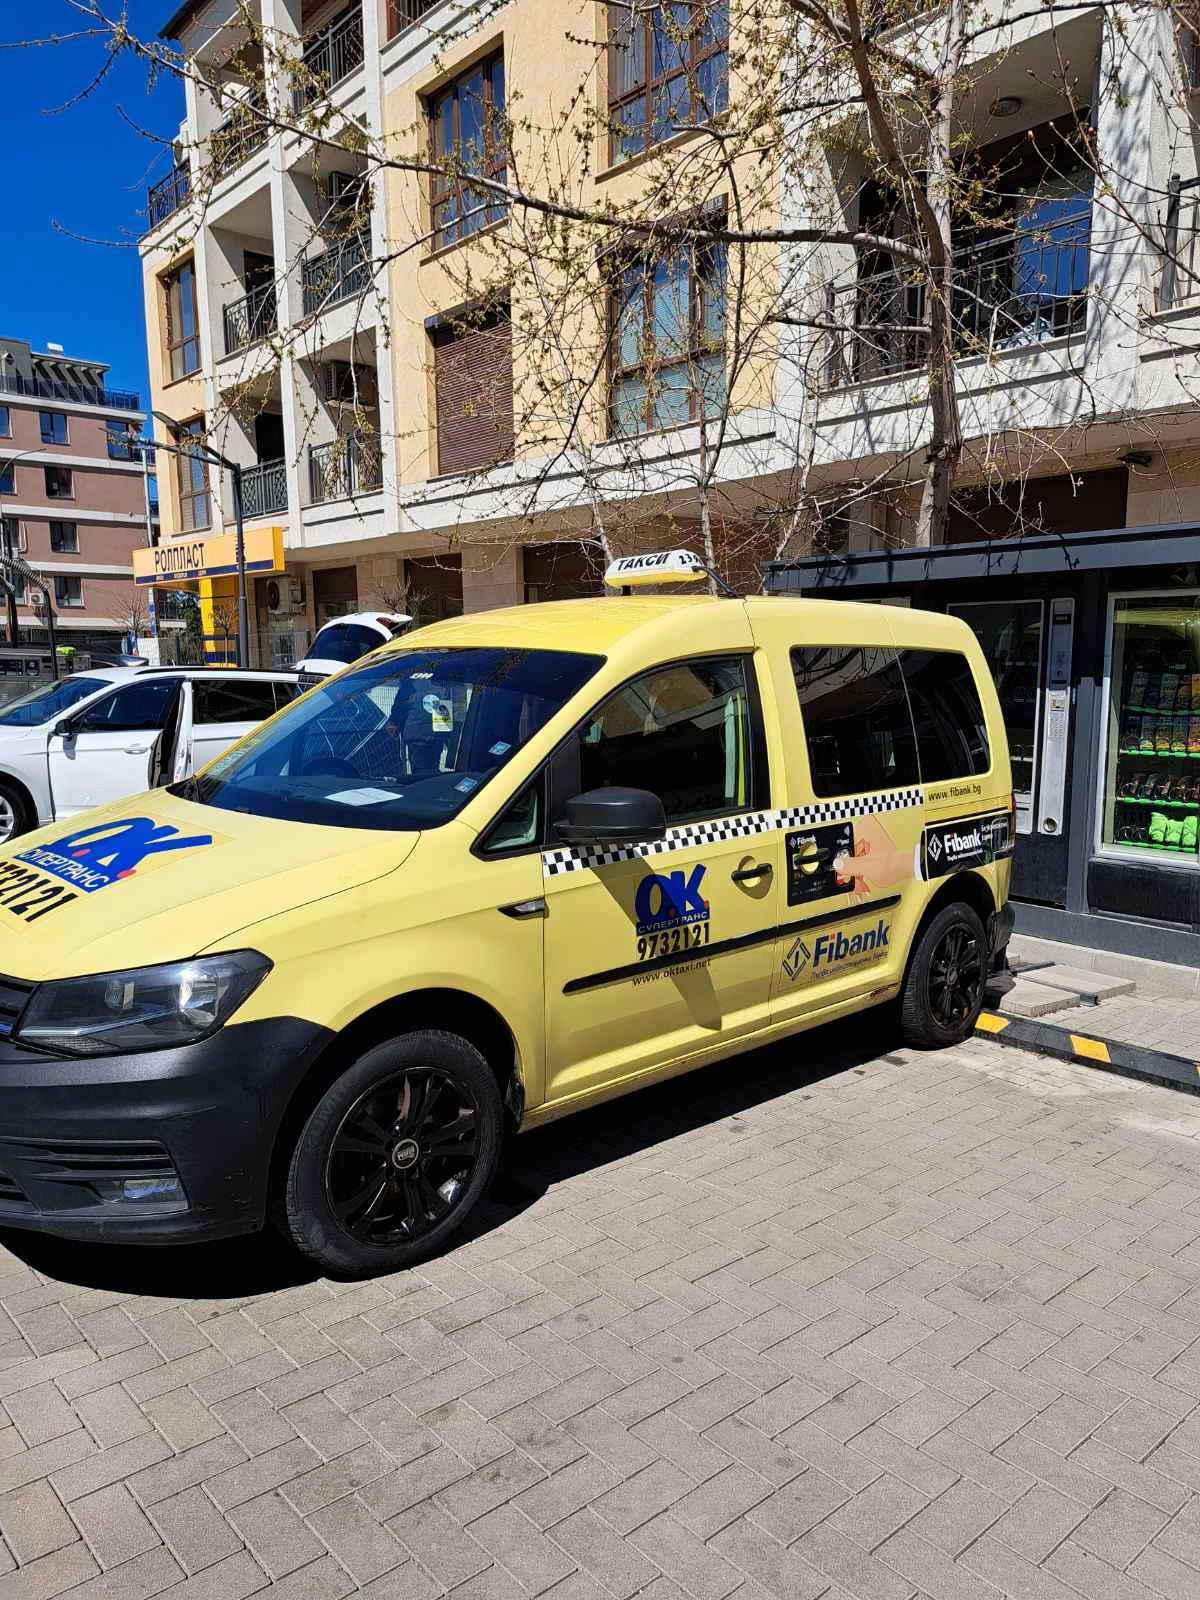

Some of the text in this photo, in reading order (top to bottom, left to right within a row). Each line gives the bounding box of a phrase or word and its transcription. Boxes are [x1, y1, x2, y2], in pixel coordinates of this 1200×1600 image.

[154, 542, 205, 572] РОЛПЛАСТ
[617, 552, 671, 571] ТАКСИ
[928, 784, 982, 802] www.fibank.bg
[943, 828, 982, 854] Fibank
[19, 849, 109, 888] СУПЕРТРАНС
[638, 910, 709, 934] СУПЕРТРАНС
[637, 923, 710, 961] 9732121
[812, 919, 891, 968] Fibank
[632, 959, 713, 987] www.oktaxi.net
